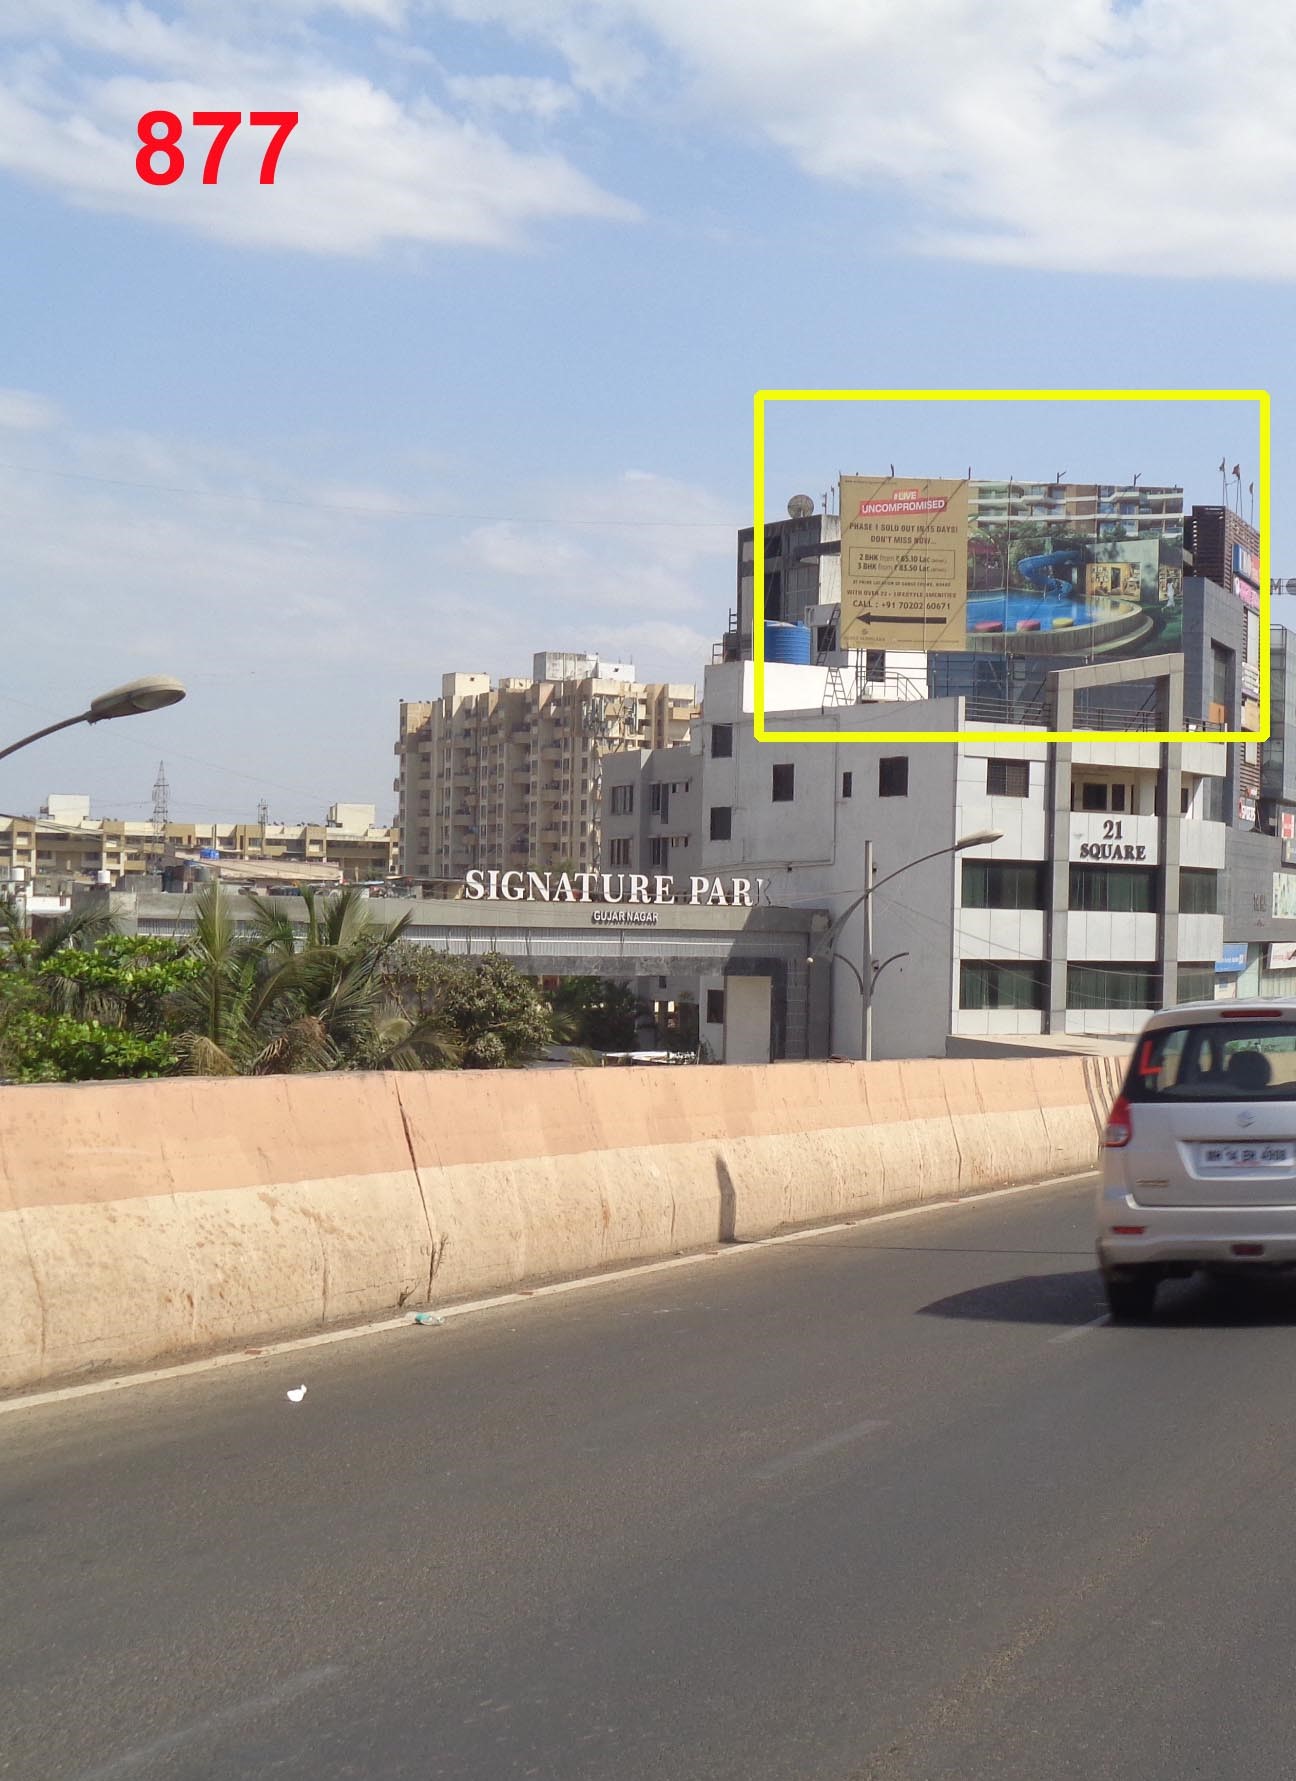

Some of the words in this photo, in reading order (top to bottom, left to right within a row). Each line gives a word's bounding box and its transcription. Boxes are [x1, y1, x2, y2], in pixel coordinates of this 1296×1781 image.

[862, 499, 945, 514] UNCOMPROMISED
[849, 522, 872, 531] PHASE
[880, 523, 899, 532] SOLD
[901, 524, 914, 532] OUT
[894, 536, 912, 544] MISS
[853, 600, 872, 608] CALL
[881, 601, 896, 609] +91
[926, 602, 950, 610] 60671
[1103, 819, 1123, 840] 21
[1079, 843, 1147, 861] SQUARE
[465, 869, 675, 905] SIGNATURE
[592, 910, 626, 924] GUJAR
[627, 911, 659, 925] NAGAR
